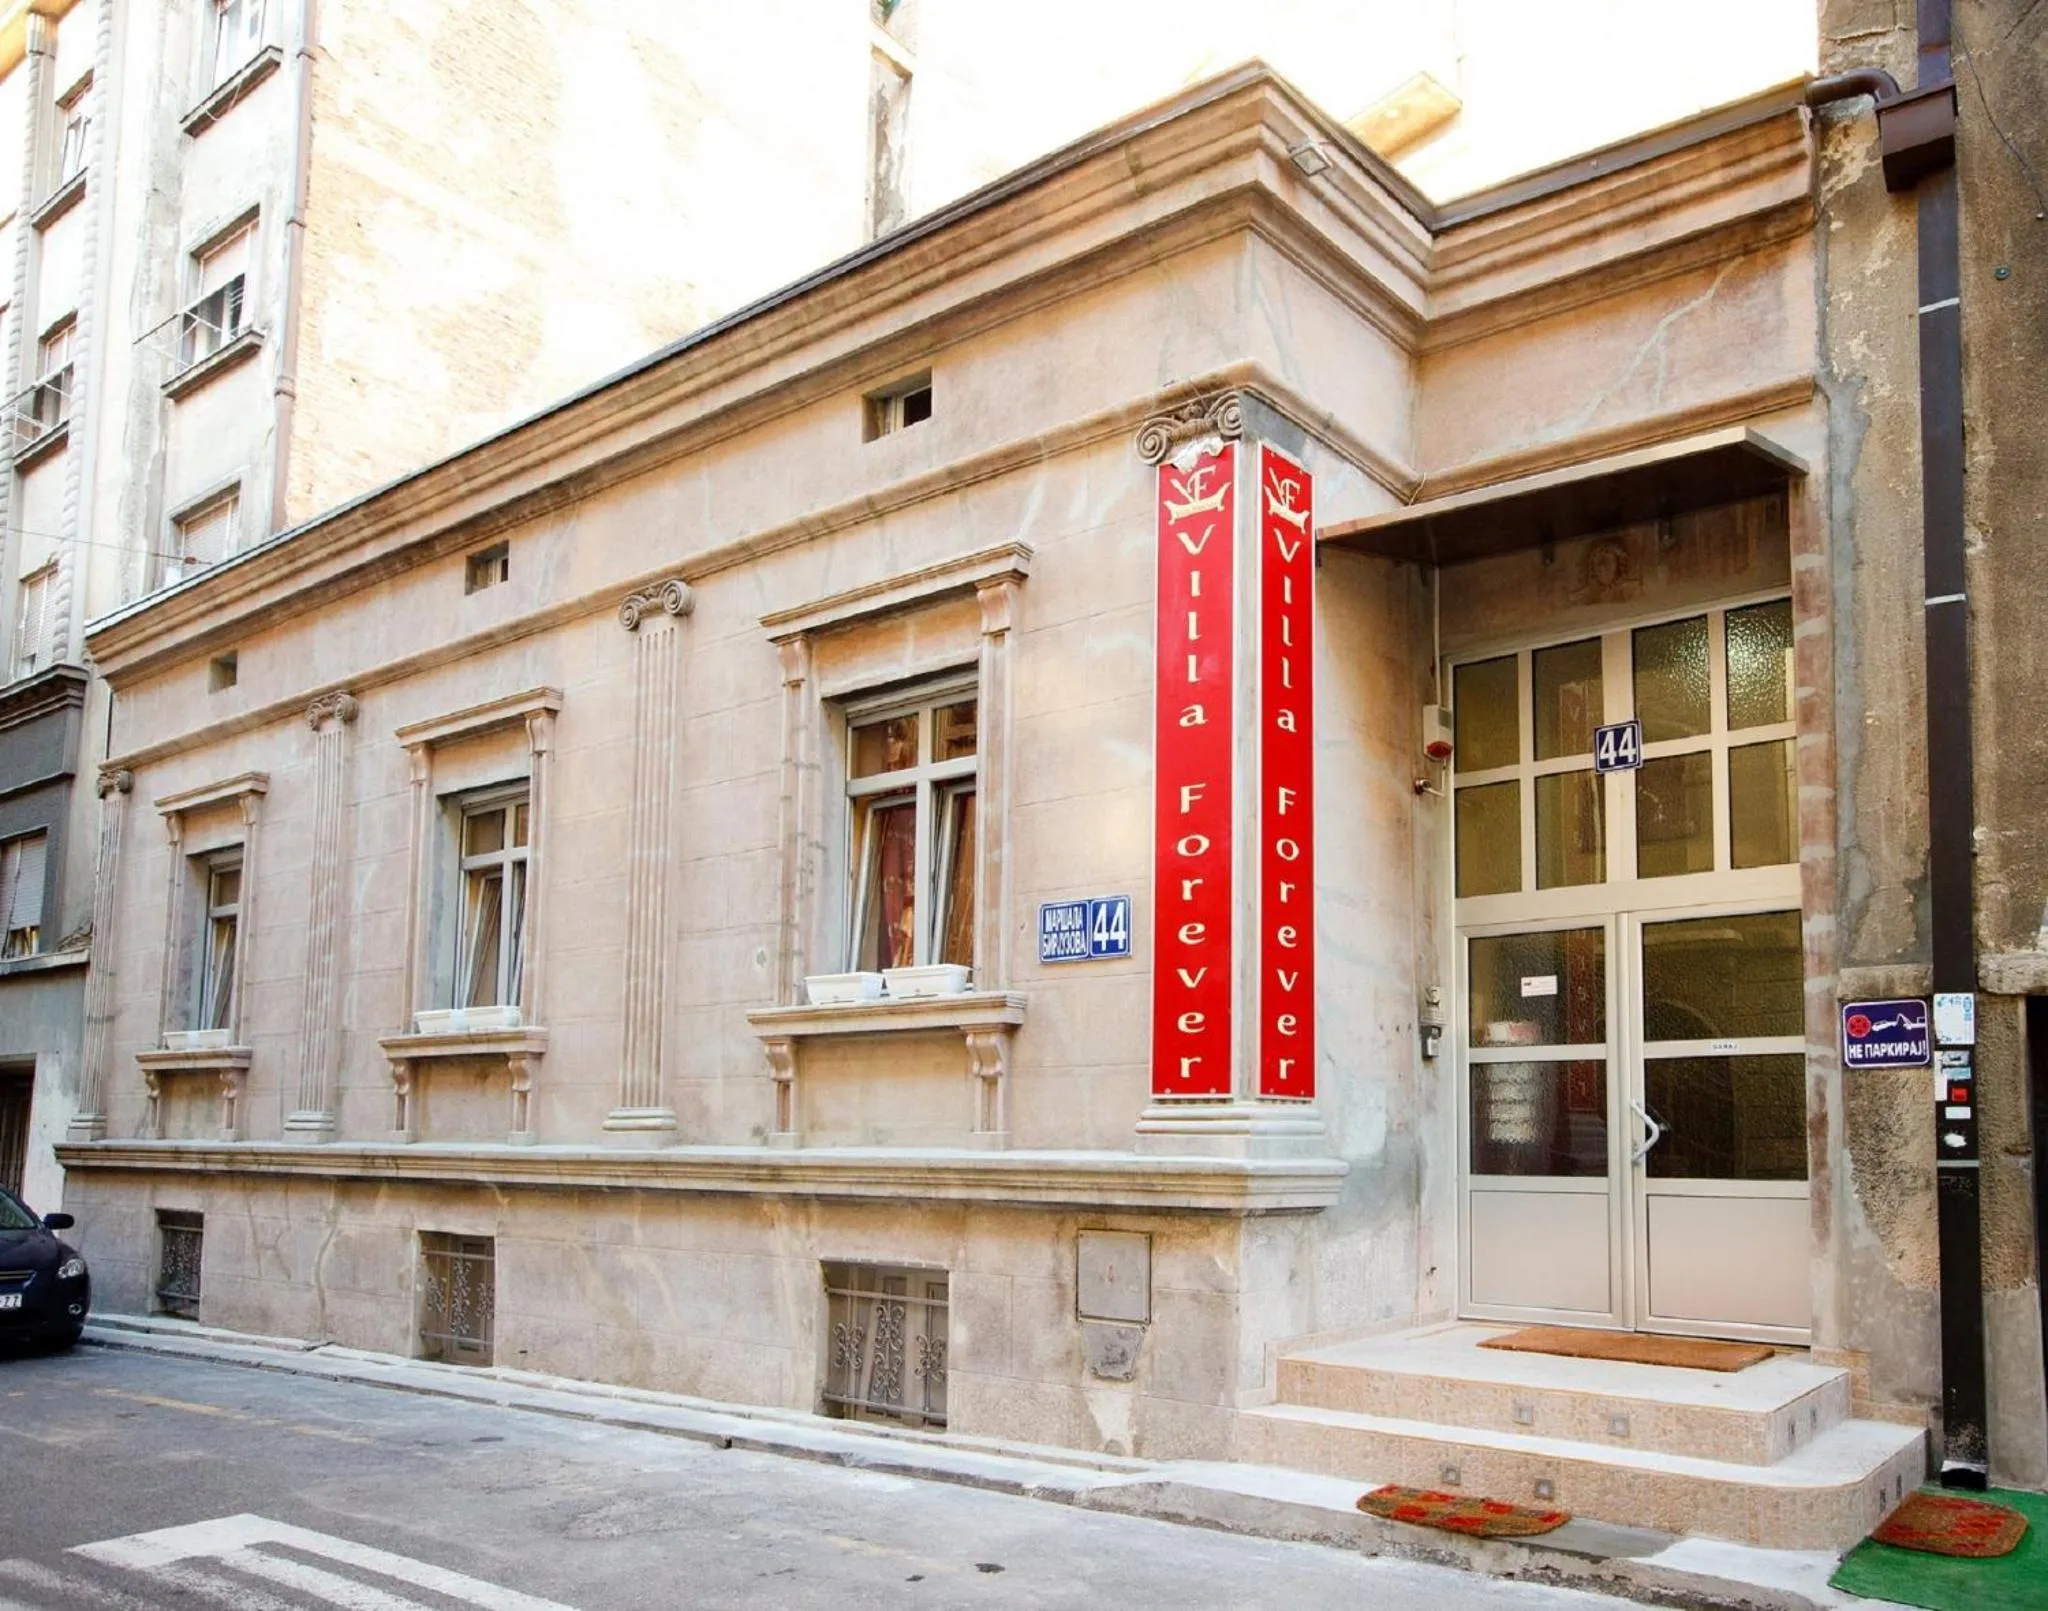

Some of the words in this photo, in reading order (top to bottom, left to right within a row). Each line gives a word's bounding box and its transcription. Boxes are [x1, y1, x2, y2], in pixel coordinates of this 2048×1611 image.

[1175, 523, 1217, 727] Villa
[1273, 527, 1301, 733] Villa
[1600, 727, 1637, 766] 44
[1093, 902, 1126, 951] 44
[1176, 783, 1210, 1078] Forever
[1275, 786, 1300, 1080] Forever
[1848, 1043, 1864, 1060] НЕ
[1864, 1040, 1927, 1059] ПАРКИРАЈ!
